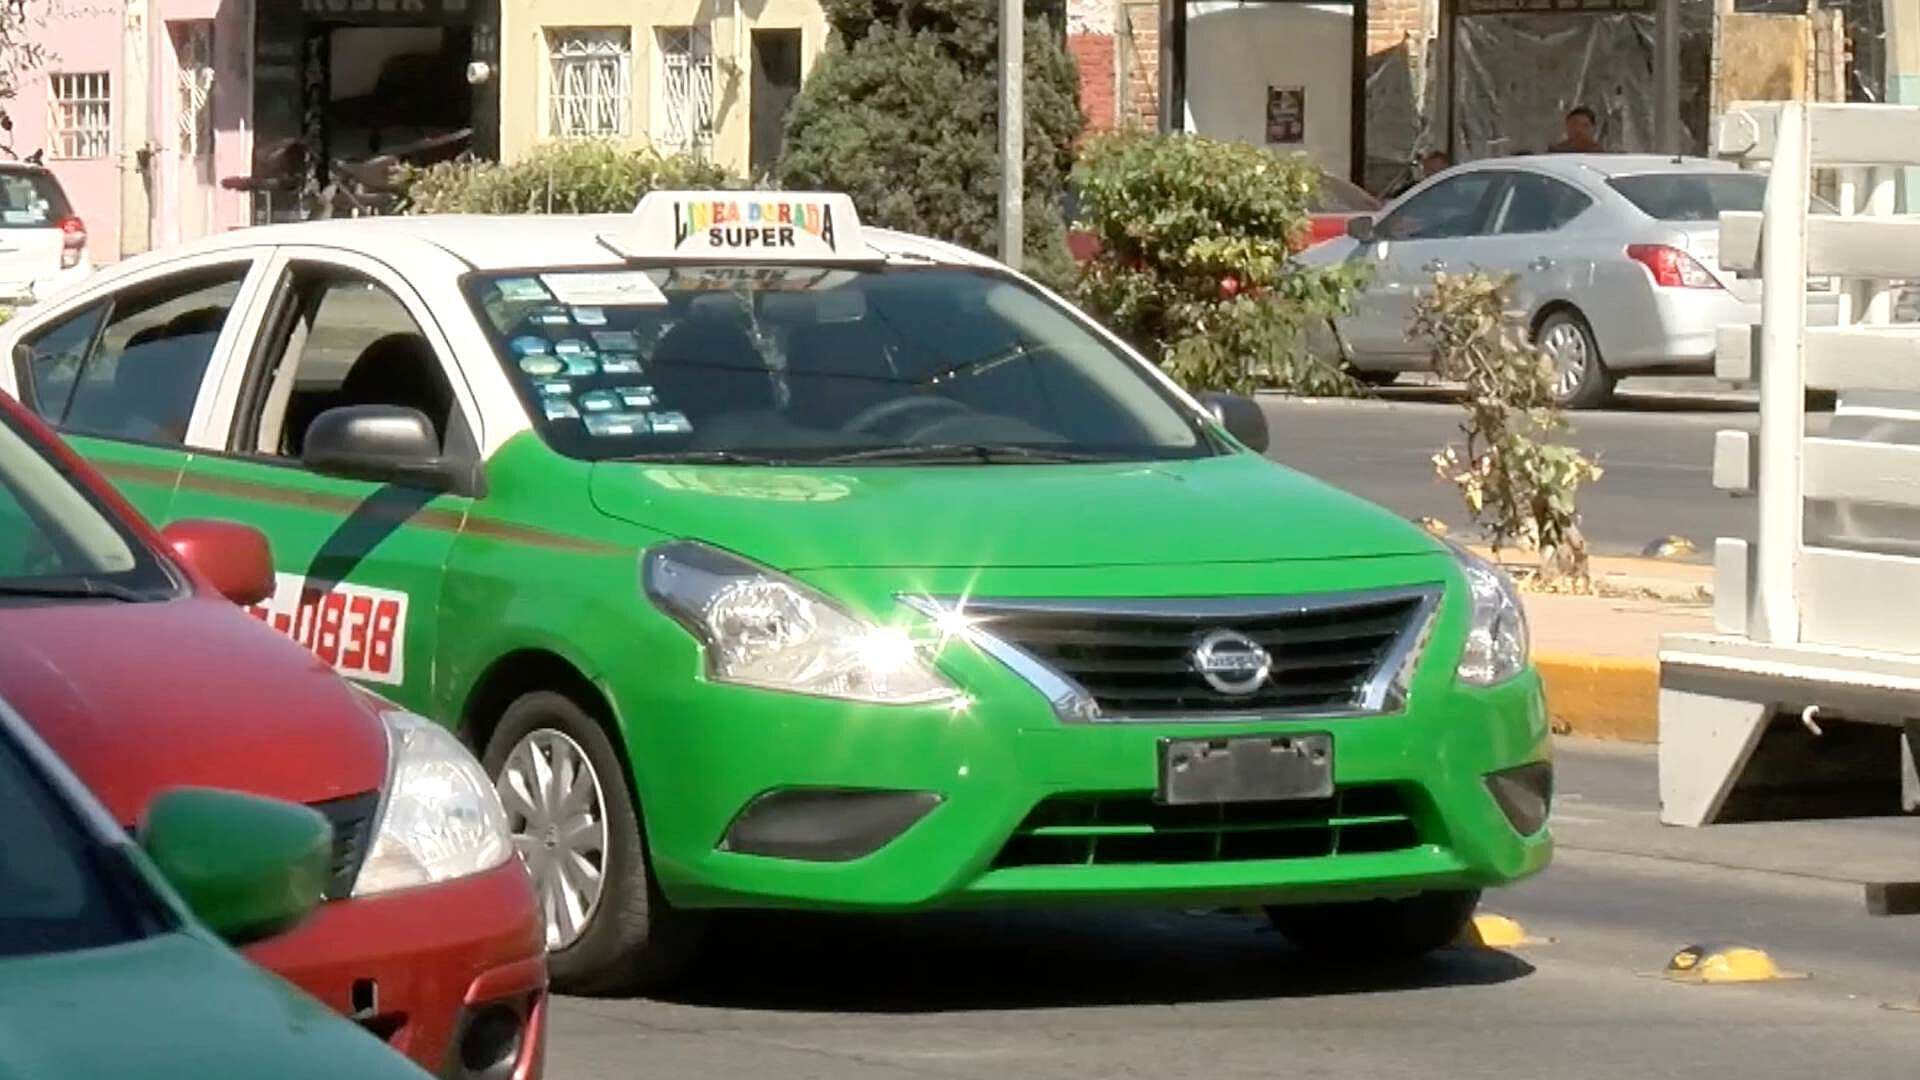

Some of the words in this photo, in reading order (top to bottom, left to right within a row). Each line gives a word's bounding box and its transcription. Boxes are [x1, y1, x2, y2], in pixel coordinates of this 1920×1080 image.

[673, 201, 740, 249] LINEA
[747, 202, 836, 252] DORADA
[709, 227, 795, 246] SUPER
[250, 588, 400, 673] -0838
